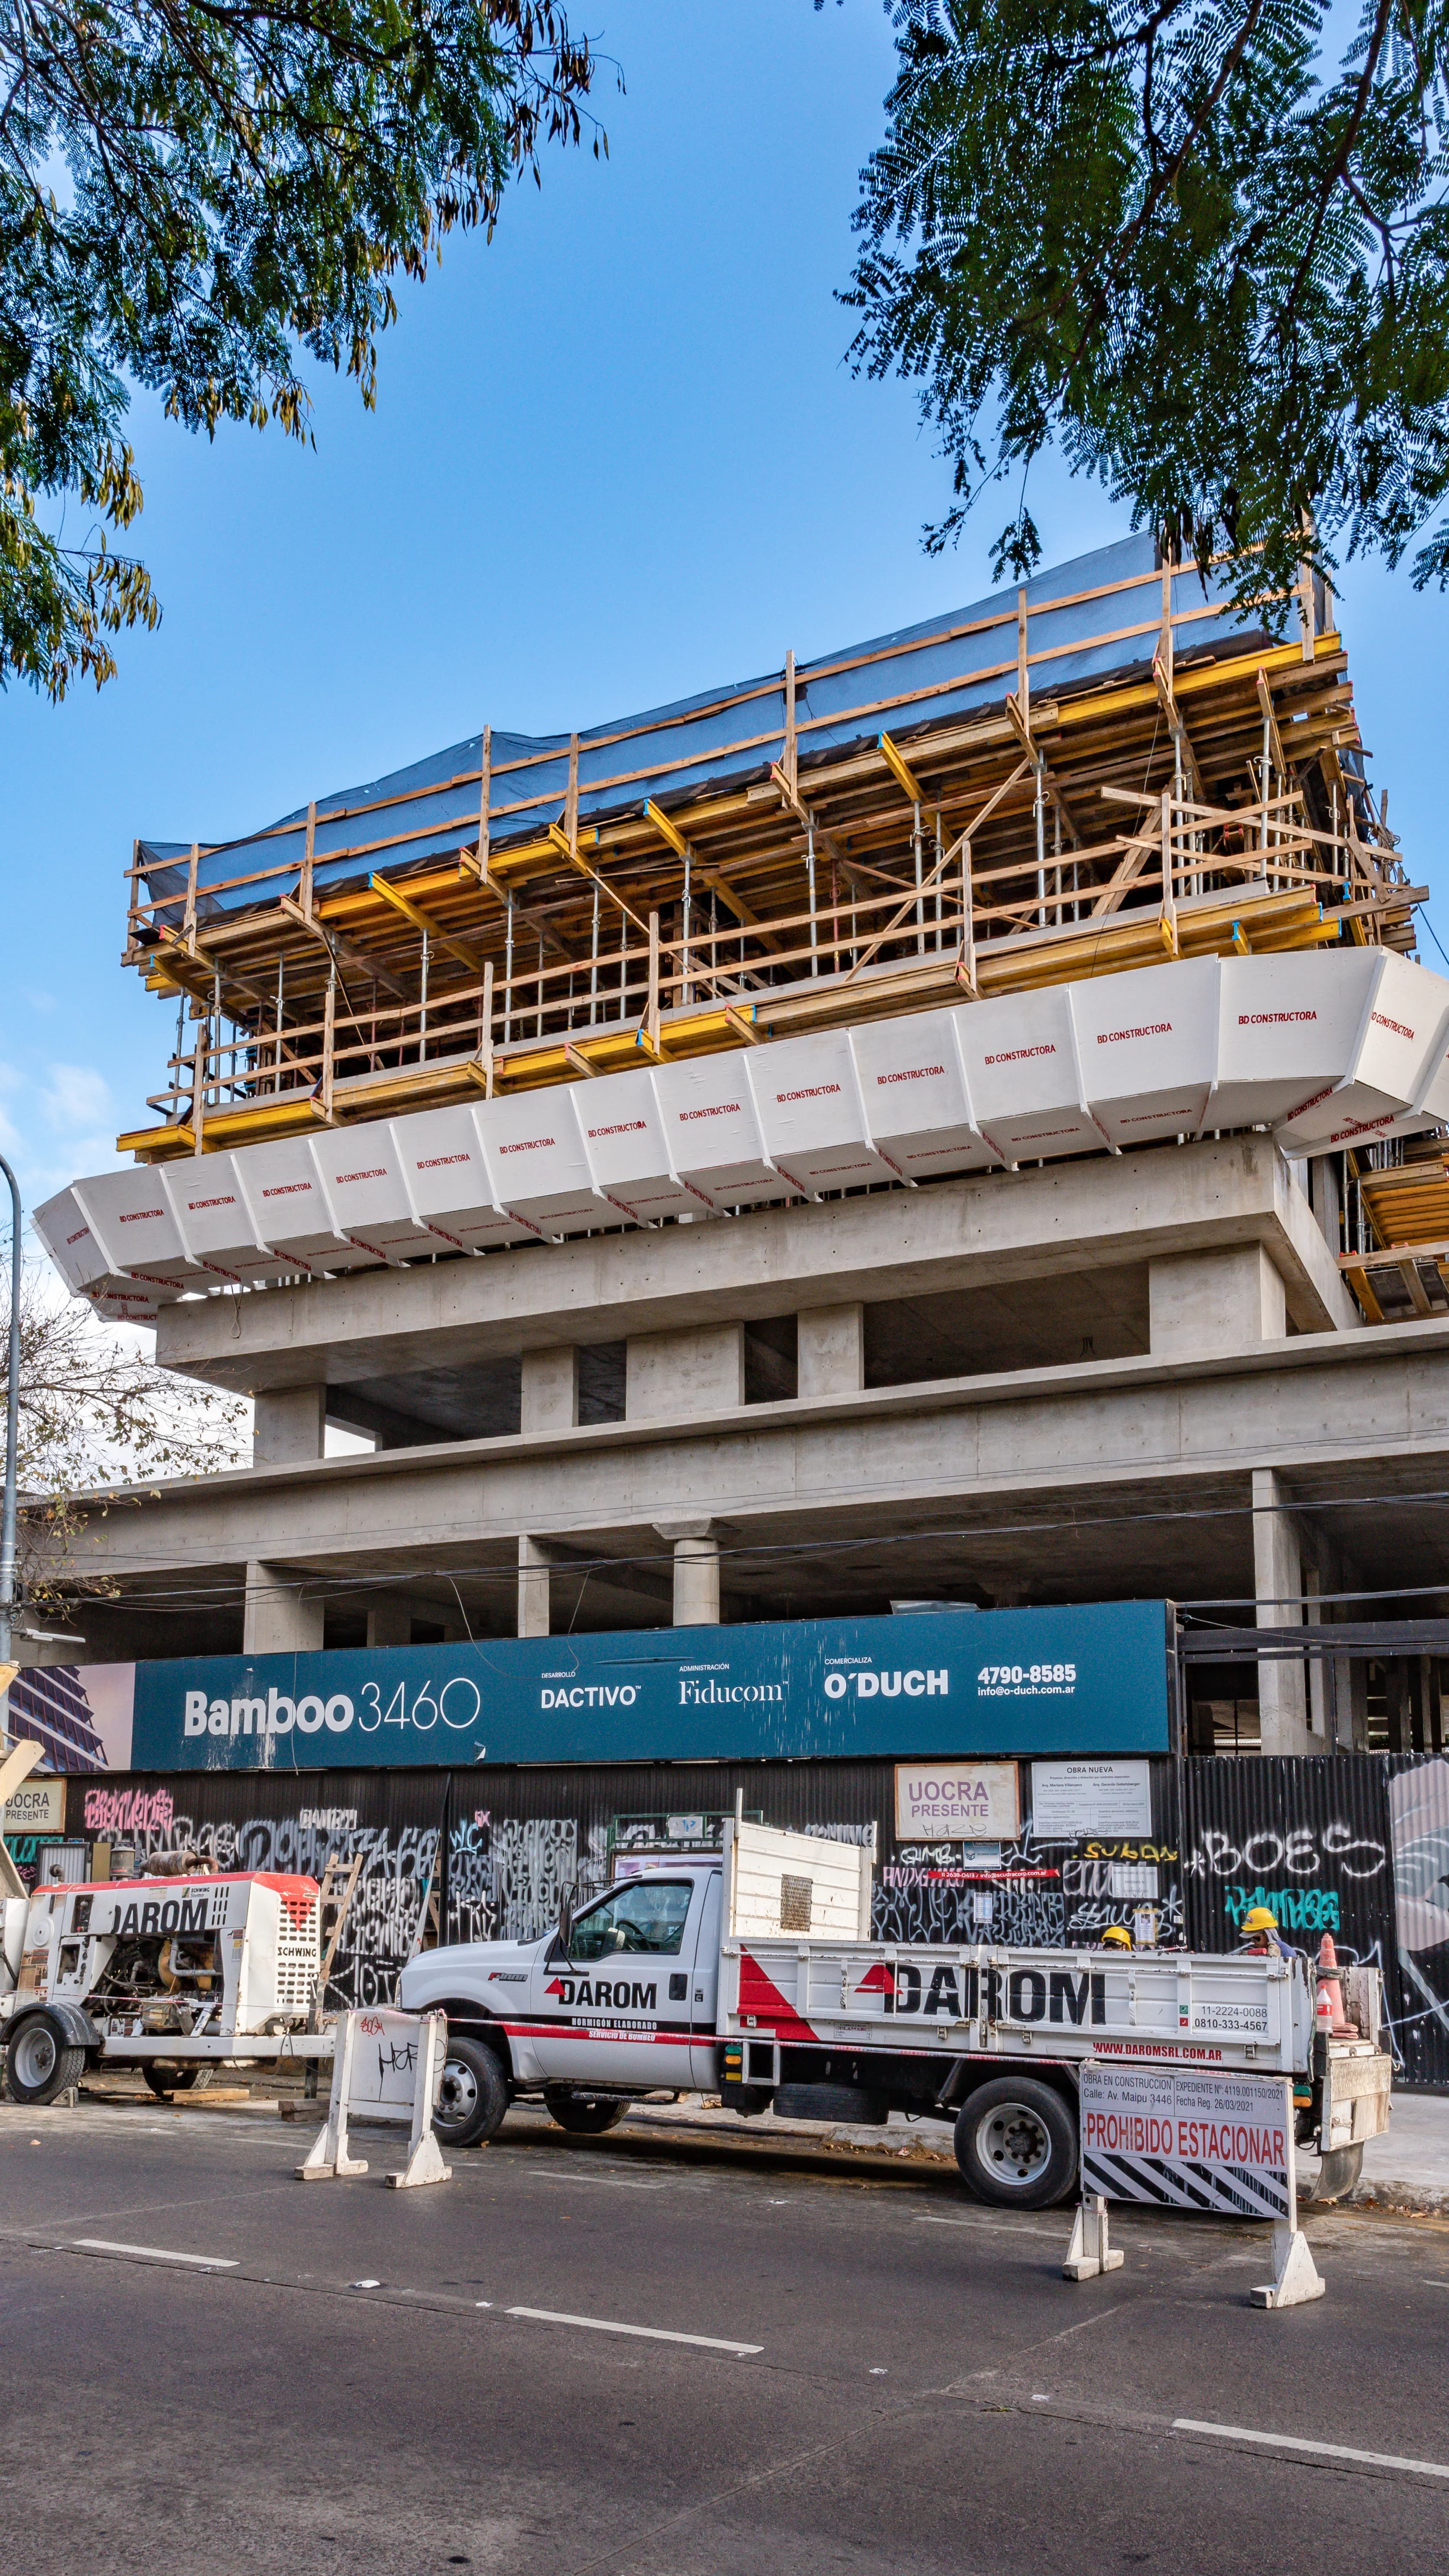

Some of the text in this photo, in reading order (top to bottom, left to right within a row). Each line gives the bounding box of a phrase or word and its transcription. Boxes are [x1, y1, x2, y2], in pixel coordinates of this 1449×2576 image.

[1239, 1011, 1317, 1025] BD CONSTRUCTORA
[1376, 1014, 1414, 1039] CONSTRUCTORA
[1097, 1023, 1172, 1044] BD CONSTRUCTORA
[985, 1045, 1056, 1064] BD CONSTRUCTORA
[877, 1066, 944, 1084] BD CONSTRUCTORA
[777, 1084, 840, 1103] BD CONSTRUCTORA
[689, 1104, 740, 1119] CONSTRUCTORA
[1287, 1087, 1333, 1121] BD CONSTRUCTORA
[597, 1121, 646, 1136] CONSTRUCTORA
[1331, 1115, 1395, 1143] BD CONSTRUCTORA
[507, 1139, 555, 1152] CONSTRUCTORA
[425, 1154, 470, 1167] CONSTRUCTORA
[344, 1169, 386, 1182] CONSTRUCTORA
[781, 1170, 805, 1191] CONSTRUCTORA
[270, 1183, 311, 1195] CONSTRUCTORA
[685, 1182, 713, 1207] BD CONSTRUCTORA
[196, 1197, 234, 1208] CONSTRUCTORA
[614, 1199, 638, 1219] CONSTRUCTORA
[127, 1210, 163, 1221] CONSTRUCTORA
[514, 1215, 541, 1235] CONSTRUCTORA
[435, 1228, 462, 1246] CONSTRUCTORA
[356, 1241, 386, 1258] CONSTRUCTORA
[281, 1252, 311, 1270] CONSTRUCTORA
[140, 1274, 183, 1288] CONSTRUCTORA
[209, 1264, 241, 1281] CONSTRUCTORA
[103, 1293, 149, 1303] ONSTRUCTORA
[679, 1663, 729, 1672] ADMINISTRACIÓN
[825, 1657, 872, 1665] COMERCIALIZA
[977, 1664, 1076, 1685] 4790-8585
[978, 1685, 1075, 1696] info@o-duch.com.ar
[908, 1781, 989, 1802] UOCRA
[6, 1809, 49, 1821] PRESENTE
[911, 1804, 989, 1817] PRESENTE
[980, 1870, 1047, 1878] info@scudracorp.com.ar
[277, 1947, 317, 1957] SCHWING
[558, 1979, 657, 2010] DAROM
[884, 1962, 1106, 2025] DAROM
[1201, 2005, 1267, 2018] 11-2224-0088
[572, 2018, 657, 2030] HORMIGÓN ELABORADO
[1194, 2018, 1268, 2031] 0810-333-4567
[1093, 2042, 1222, 2061] WWW.DAROMSRL.COM.AR
[1083, 2073, 1172, 2090] OBRA EN CONSTRUCCION
[1084, 2088, 1172, 2105] Calle: Av. Maipu 3446
[1176, 2081, 1213, 2094] EXPEDIENTE
[1224, 2084, 1283, 2100] 4119.001150/2021
[1176, 2096, 1253, 2112] Fecha Reg. 26/03/2021
[1087, 2112, 1285, 2166] PROHIBIDO ESTACIONAR
